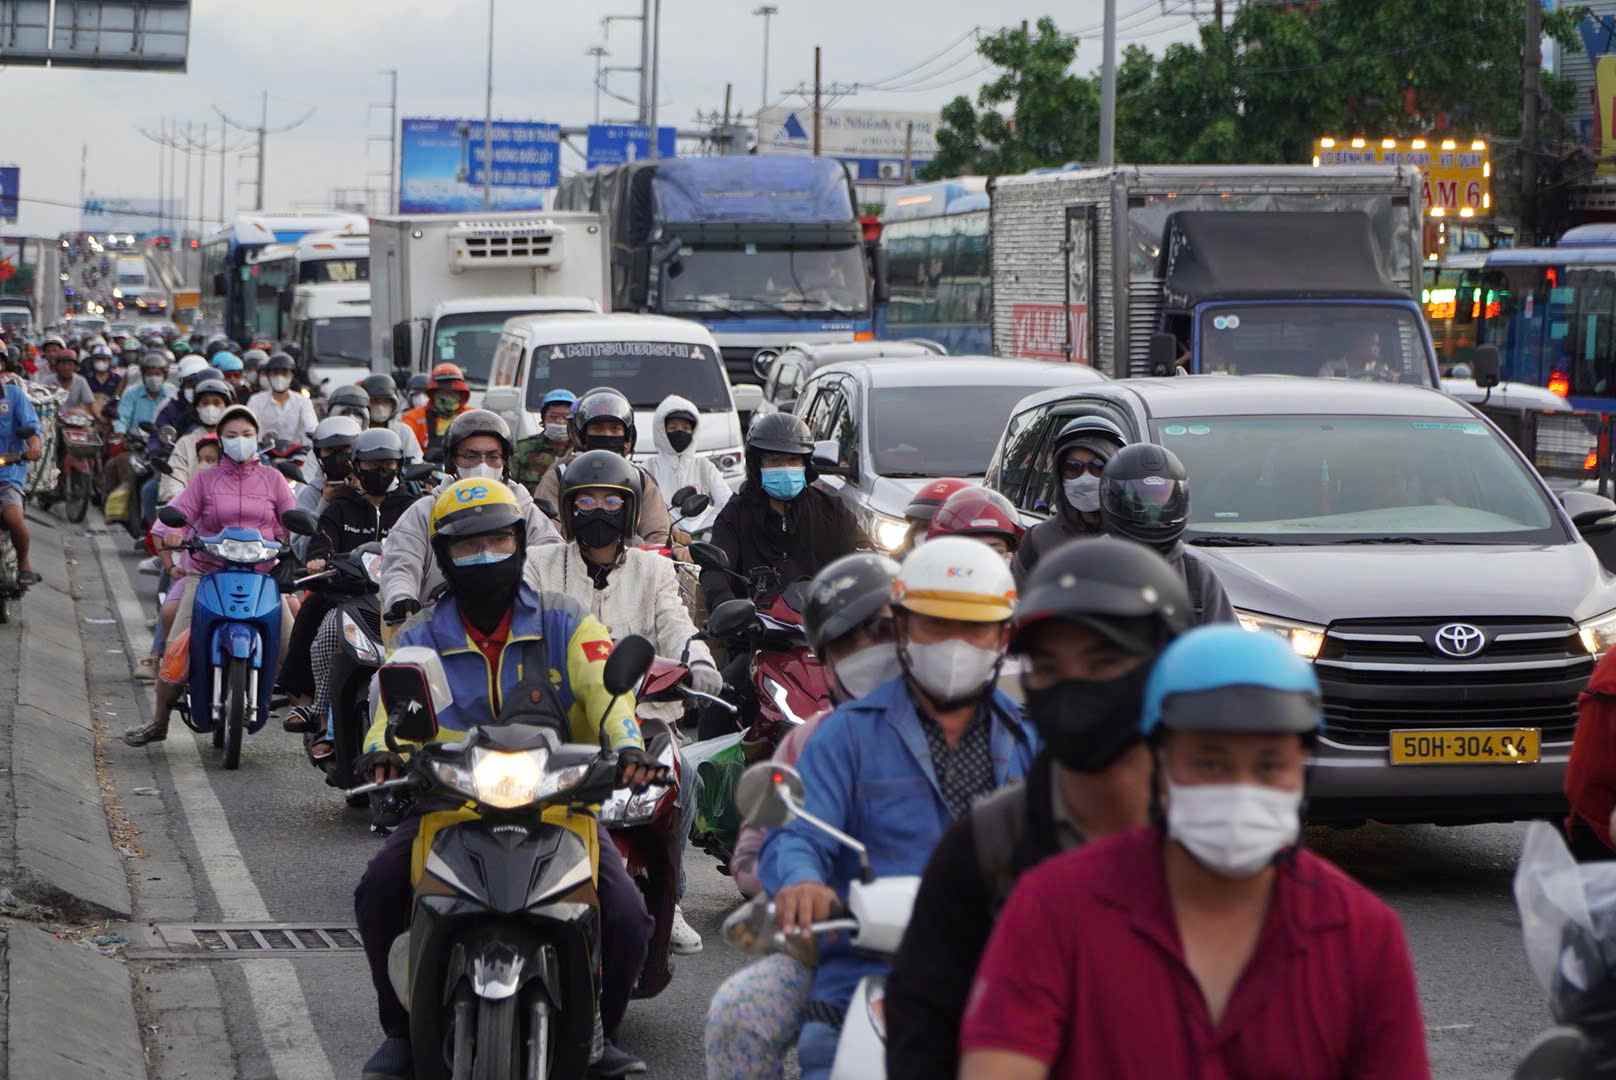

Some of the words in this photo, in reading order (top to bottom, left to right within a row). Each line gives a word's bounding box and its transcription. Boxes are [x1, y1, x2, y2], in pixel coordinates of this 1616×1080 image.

[1467, 182, 1480, 209] 6
[566, 343, 689, 358] MITSUBISHI
[1404, 736, 1527, 757] 50H-304.94
